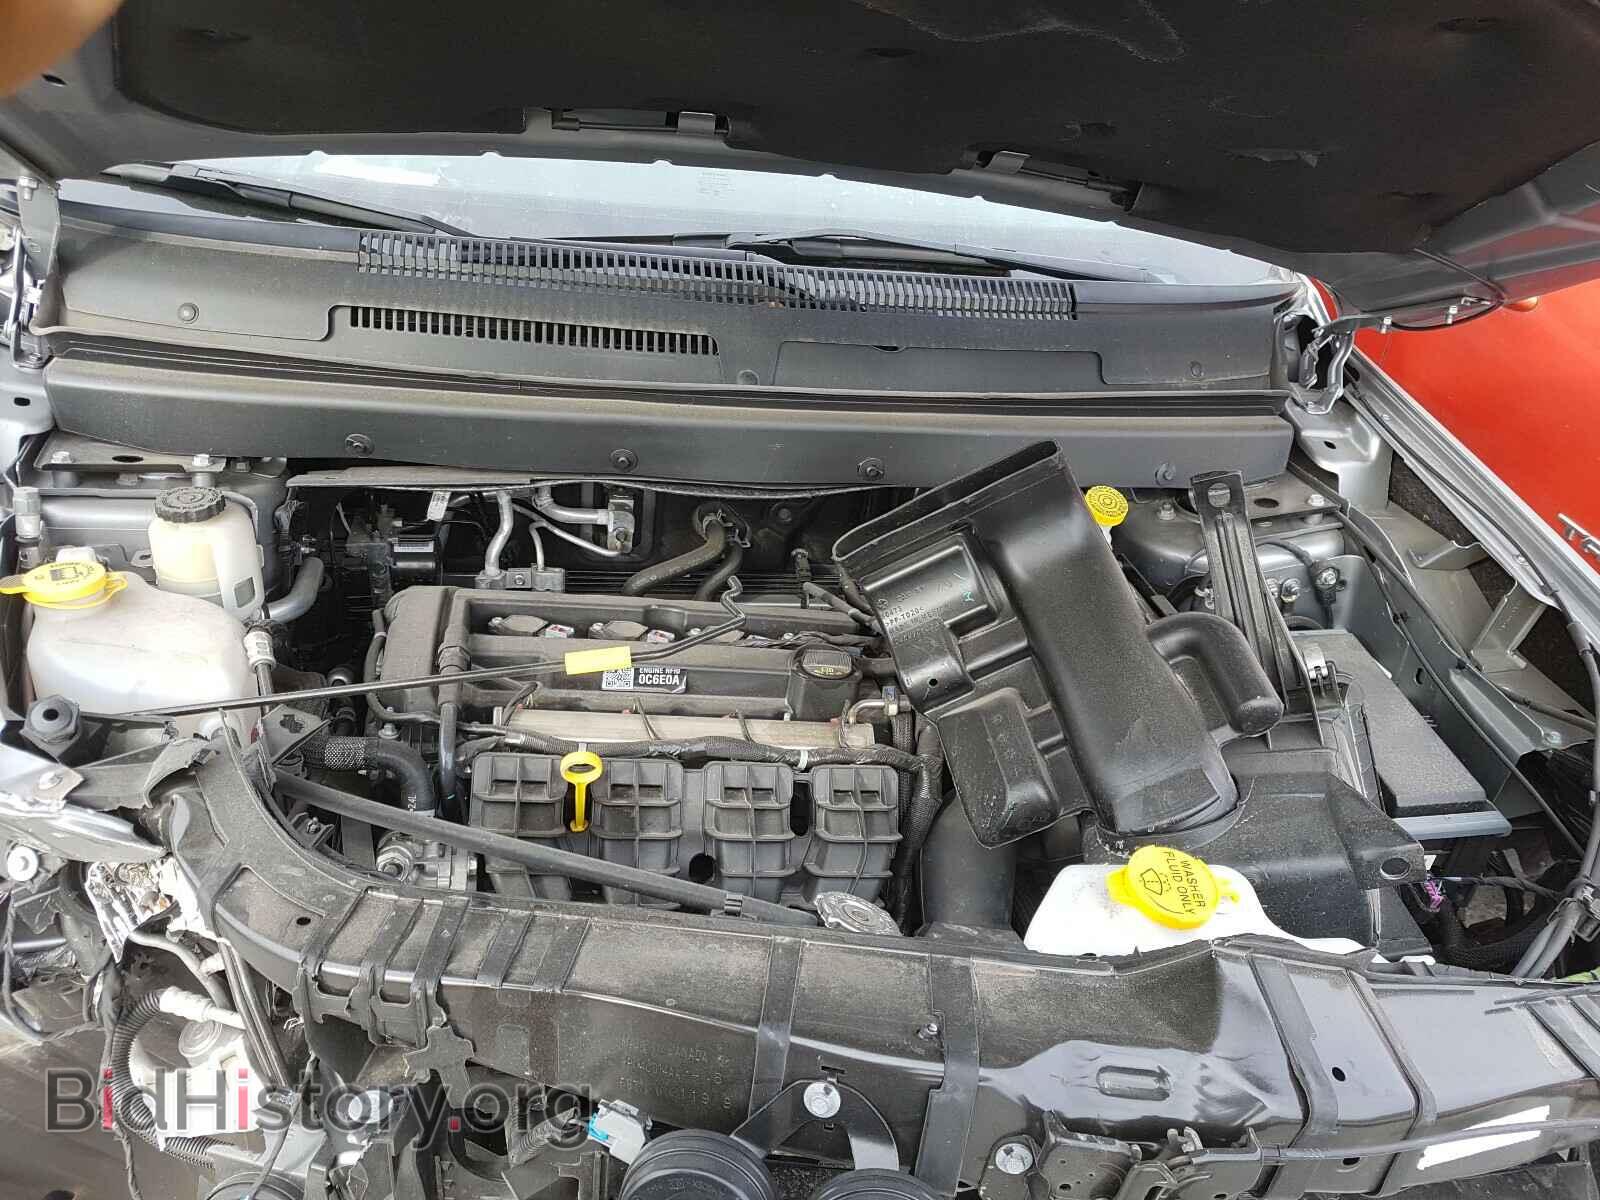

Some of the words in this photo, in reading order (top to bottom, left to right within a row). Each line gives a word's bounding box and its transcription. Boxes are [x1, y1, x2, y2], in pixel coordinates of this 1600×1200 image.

[1163, 850, 1183, 882] FLUID
[1177, 886, 1195, 915] ONLY
[1180, 860, 1206, 908] WASHER
